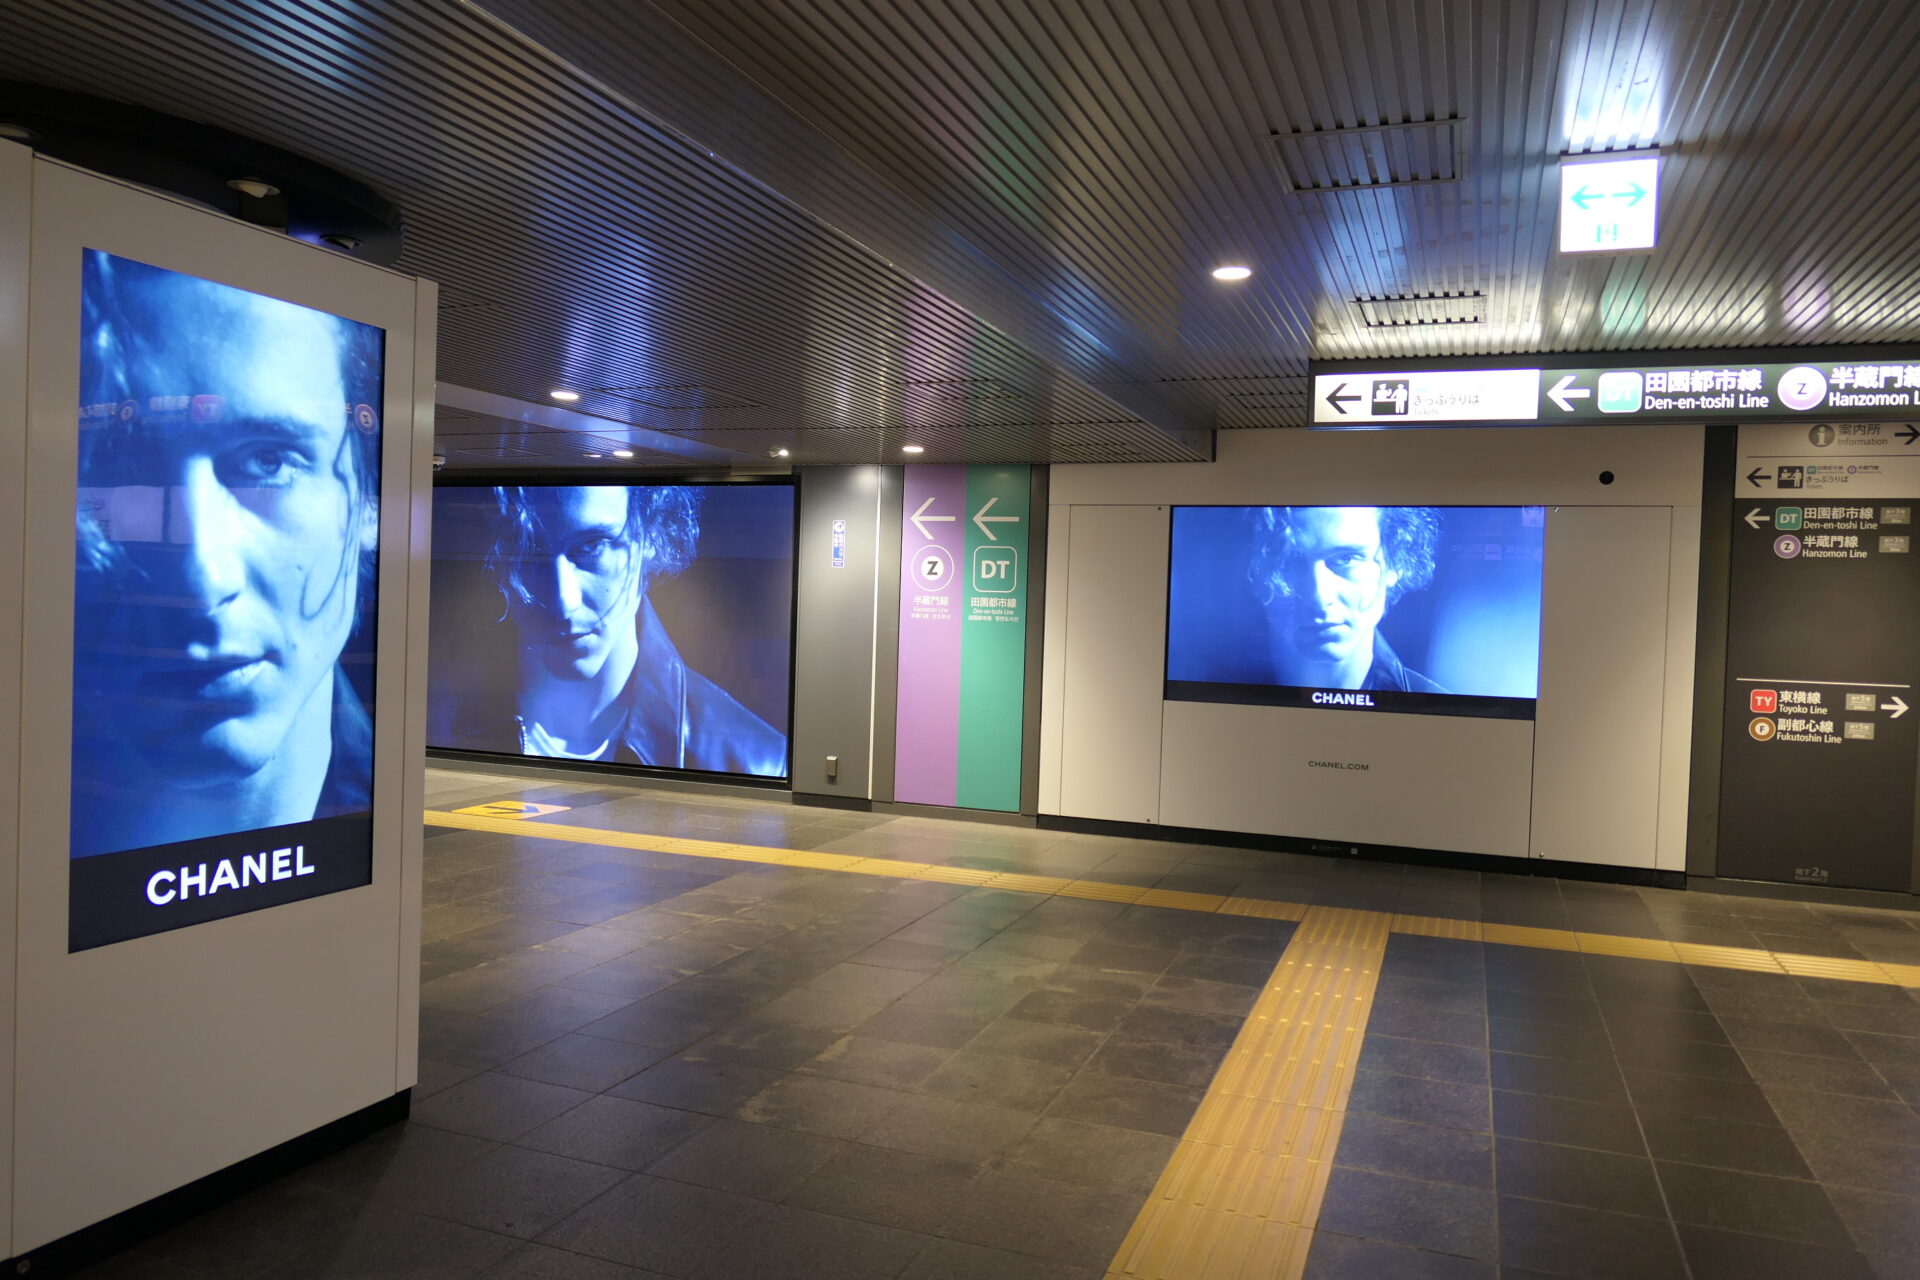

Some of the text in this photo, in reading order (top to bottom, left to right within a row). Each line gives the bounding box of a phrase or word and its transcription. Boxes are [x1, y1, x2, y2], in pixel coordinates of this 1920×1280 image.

[1645, 369, 1763, 393] 田園都市線
[1797, 383, 1807, 395] Z
[1645, 393, 1769, 410] Den-en-toshi Line
[1829, 392, 1909, 407] Hanzomon
[1839, 424, 1881, 436] 案内所
[1838, 438, 1888, 447] Information
[1780, 514, 1798, 524] DT
[1804, 507, 1874, 520] 田園都市線
[1803, 521, 1878, 530] Den-en-toshi Line
[1783, 543, 1791, 551] Z
[1803, 536, 1858, 549] 半蔵門線
[1802, 549, 1868, 558] Hanzomon Line
[927, 561, 938, 576] Z
[981, 560, 1010, 579] DT
[970, 597, 1016, 608] 田園都市線
[1312, 692, 1375, 706] CHANEL
[1755, 696, 1773, 707] TY
[1779, 690, 1821, 705] 東横線
[1779, 704, 1828, 715] Toyoko Line
[1759, 725, 1765, 733] F
[1777, 718, 1834, 733] 副都心線
[1777, 732, 1842, 744] Fukutoshin Line
[1308, 761, 1369, 771] CHANEL.COM
[146, 845, 315, 905] CHANEL
